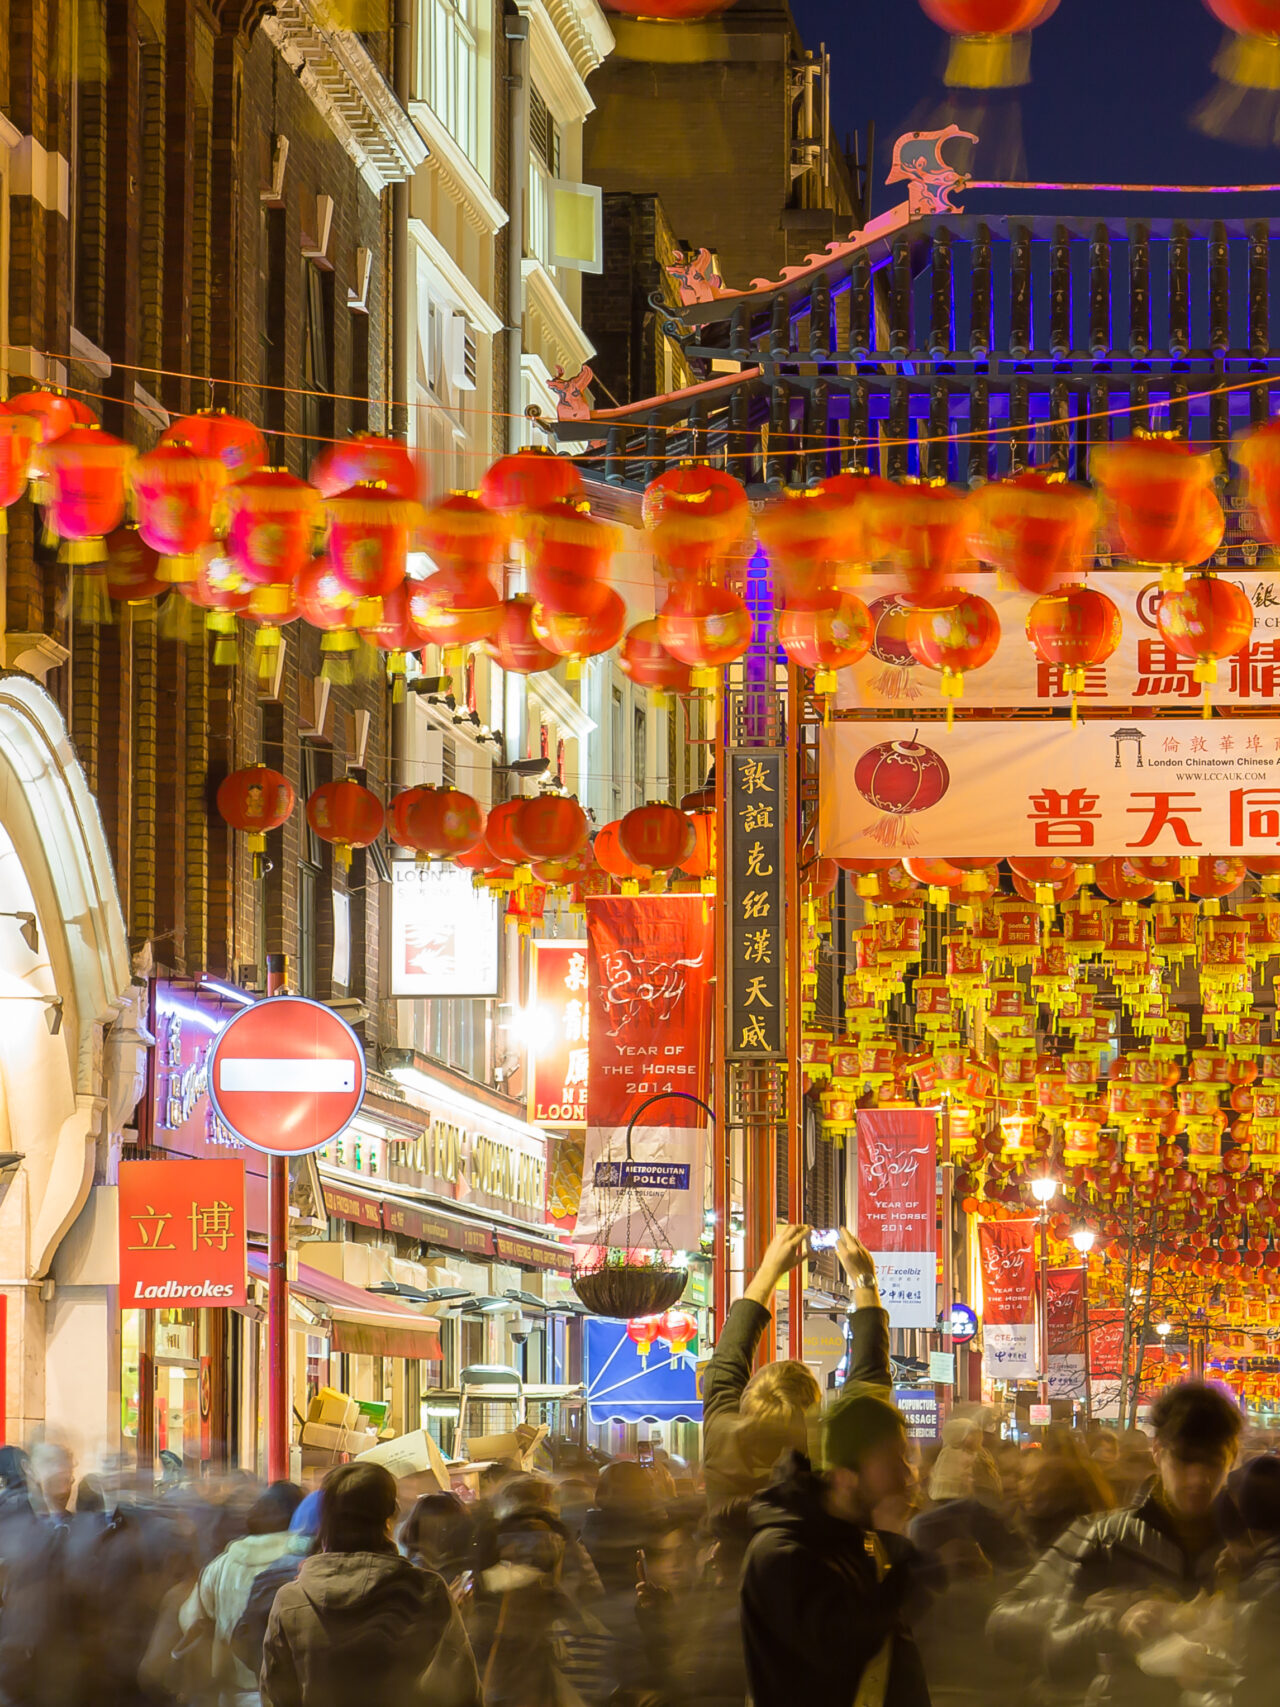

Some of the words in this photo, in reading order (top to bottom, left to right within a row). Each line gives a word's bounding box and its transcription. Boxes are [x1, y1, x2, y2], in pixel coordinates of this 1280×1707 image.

[1148, 757, 1184, 767] London
[1185, 757, 1234, 767] Chinatown
[1237, 756, 1274, 766] Chinese
[1176, 772, 1266, 782] WWW.LCCAUK.COM
[616, 1045, 658, 1056] YEAR
[664, 1045, 685, 1055] OF
[602, 1065, 634, 1075] THE
[642, 1064, 697, 1075] HORSE
[625, 1082, 673, 1094] 2014
[536, 1104, 585, 1121] LOON
[633, 1175, 676, 1185] POLICE
[875, 1200, 903, 1209] YEAR
[905, 1200, 920, 1208] OF
[891, 1212, 928, 1220] HORSE
[127, 1200, 236, 1252] 立博
[881, 1223, 913, 1232] 2014
[134, 1280, 234, 1299] Ladbrokes
[905, 1414, 937, 1425] ASSAGE
